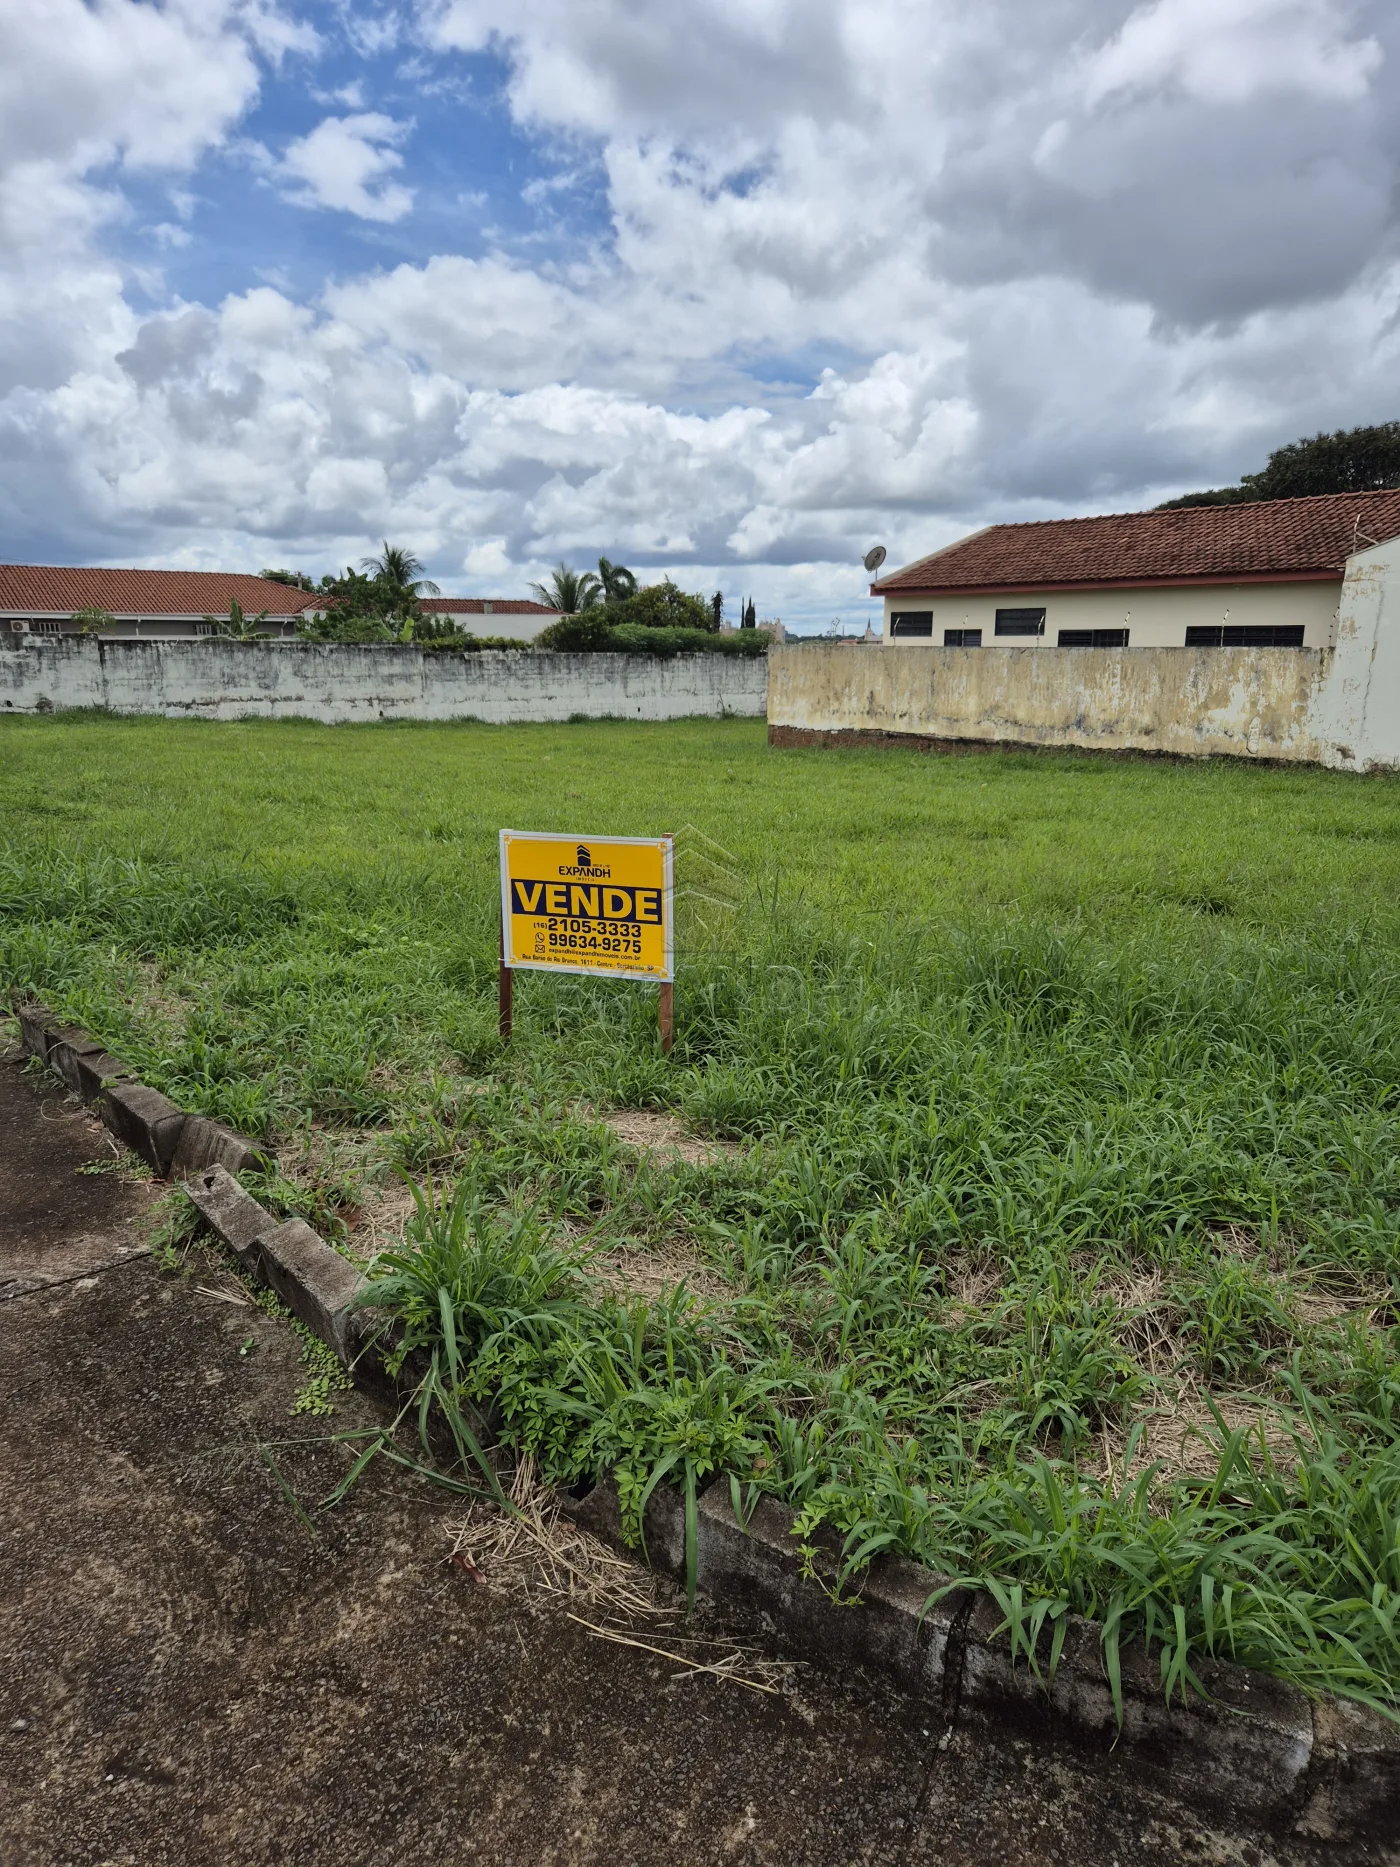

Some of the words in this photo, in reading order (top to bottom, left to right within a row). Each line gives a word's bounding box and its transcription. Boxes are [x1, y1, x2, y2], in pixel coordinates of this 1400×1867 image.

[558, 865, 611, 878] EXPANDH
[514, 881, 659, 922] VENDE
[548, 918, 642, 938] 2105-3333
[548, 933, 642, 953] 99634-9275
